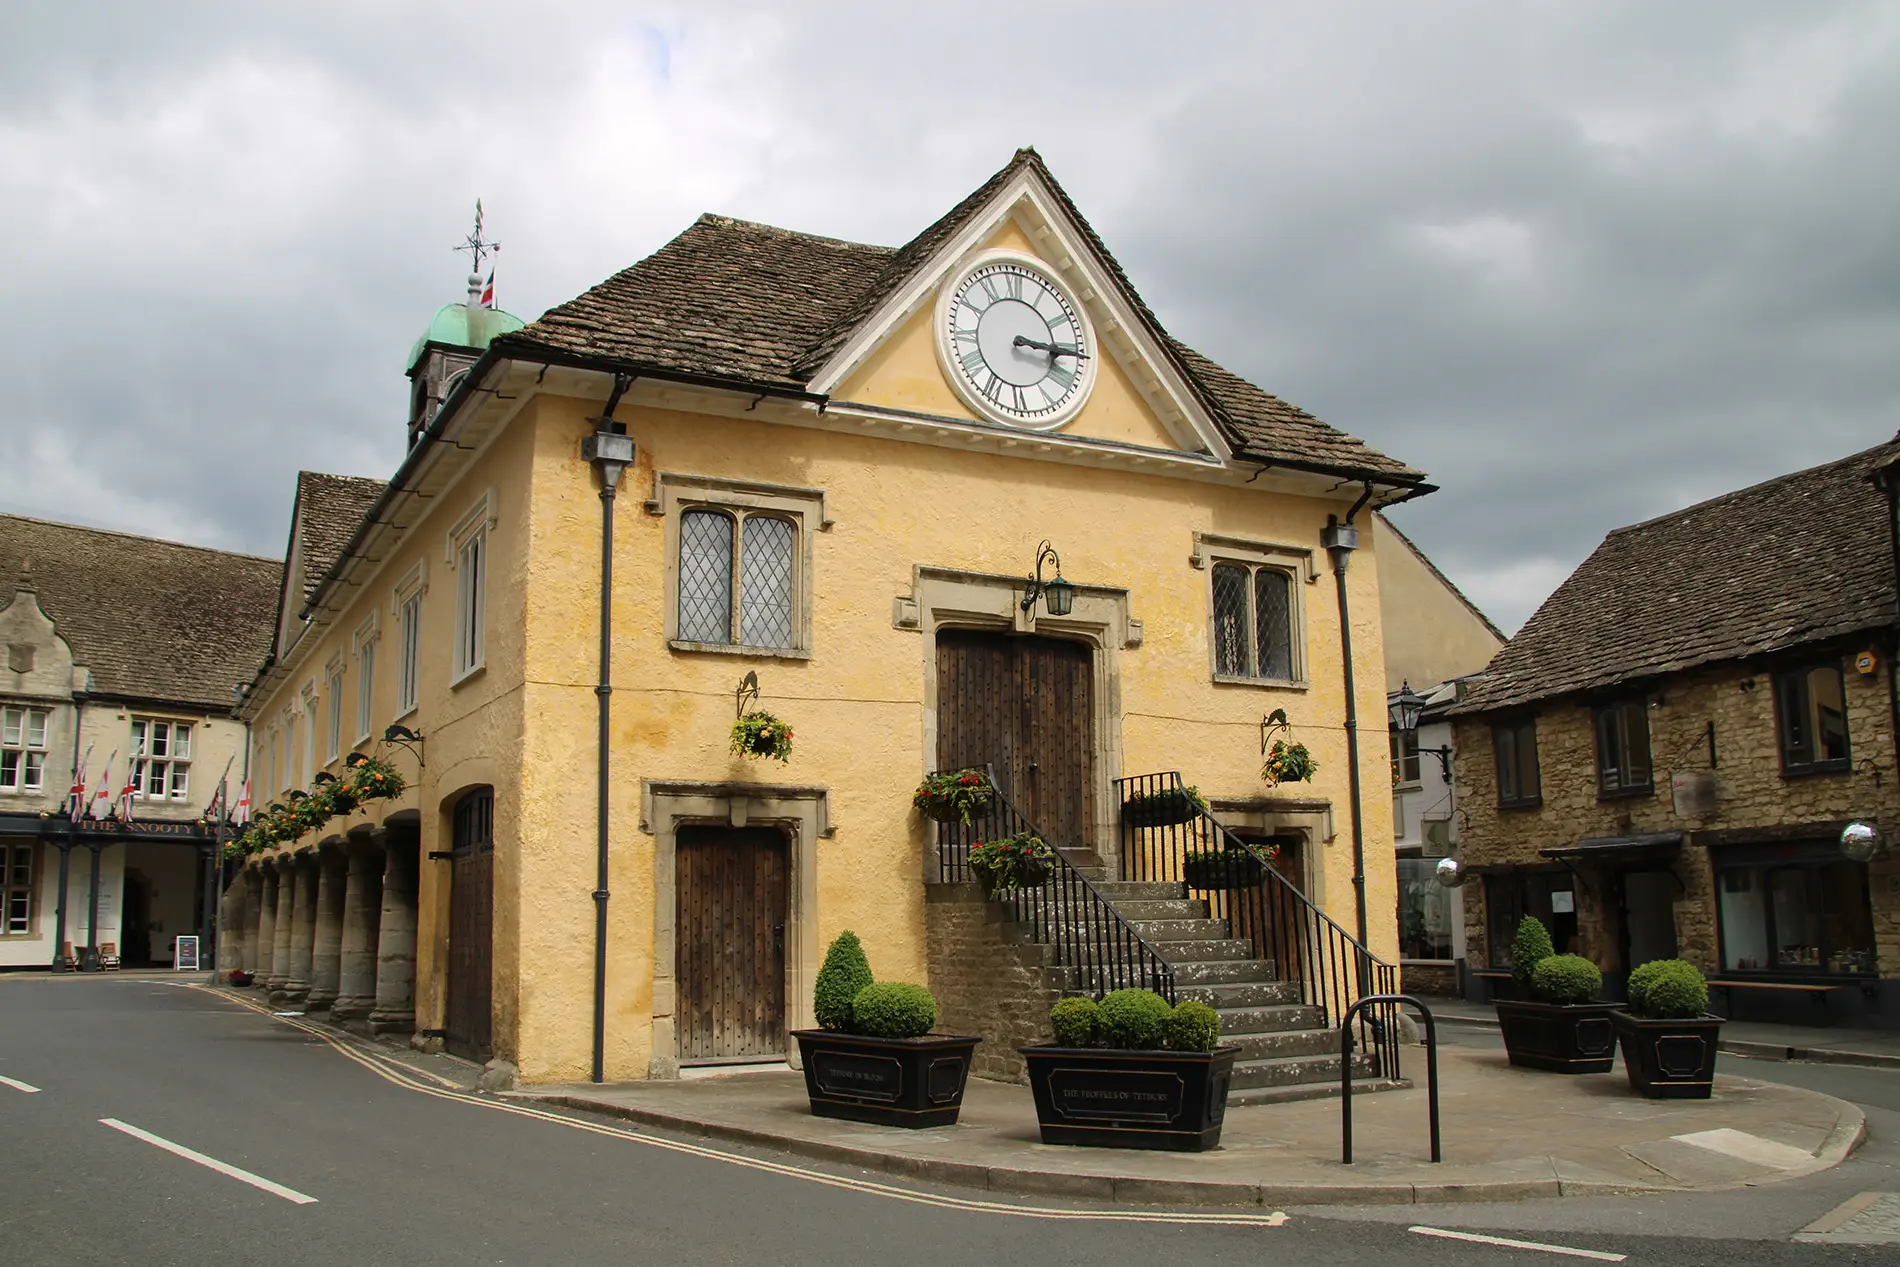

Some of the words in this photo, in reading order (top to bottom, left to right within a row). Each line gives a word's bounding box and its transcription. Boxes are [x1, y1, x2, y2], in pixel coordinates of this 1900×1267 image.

[80, 820, 117, 832] THE
[125, 822, 195, 835] SNOOTY
[1063, 1089, 1079, 1098] THE
[1119, 1091, 1130, 1100] OF
